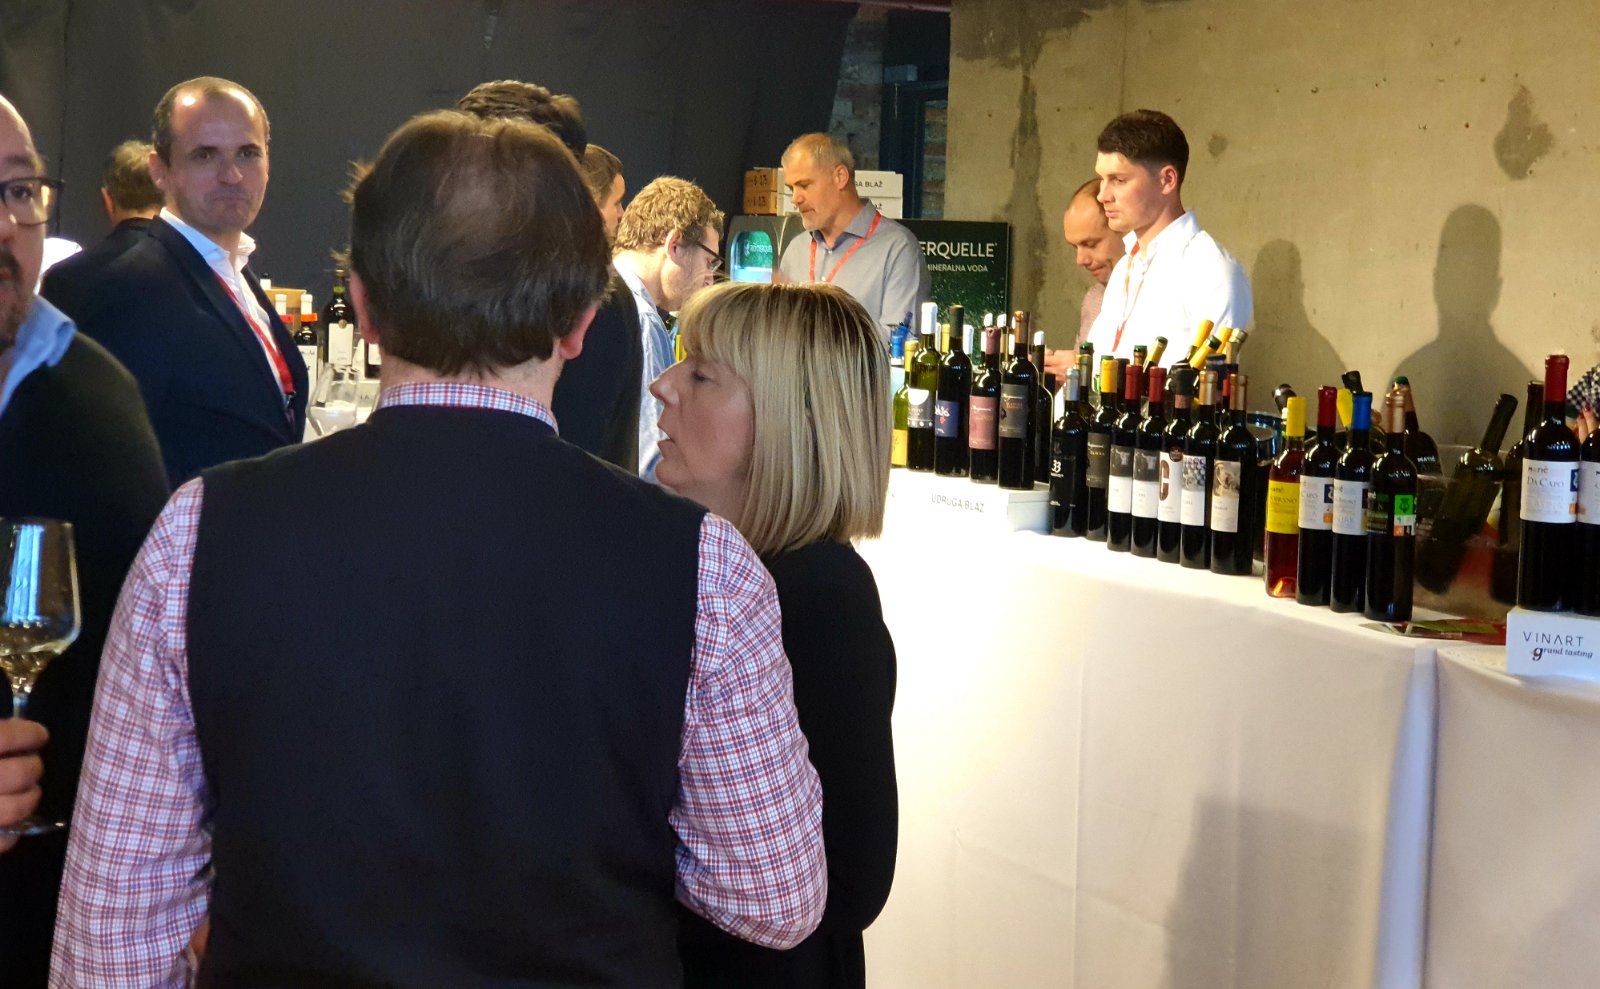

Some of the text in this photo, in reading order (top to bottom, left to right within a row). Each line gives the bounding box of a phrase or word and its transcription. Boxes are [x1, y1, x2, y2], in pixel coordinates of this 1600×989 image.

[865, 180, 883, 188] BLAŽ
[967, 264, 989, 273] VODA
[931, 493, 963, 508] UDRUGA
[1523, 631, 1584, 647] VINART
[1532, 647, 1593, 661] grand tasting
